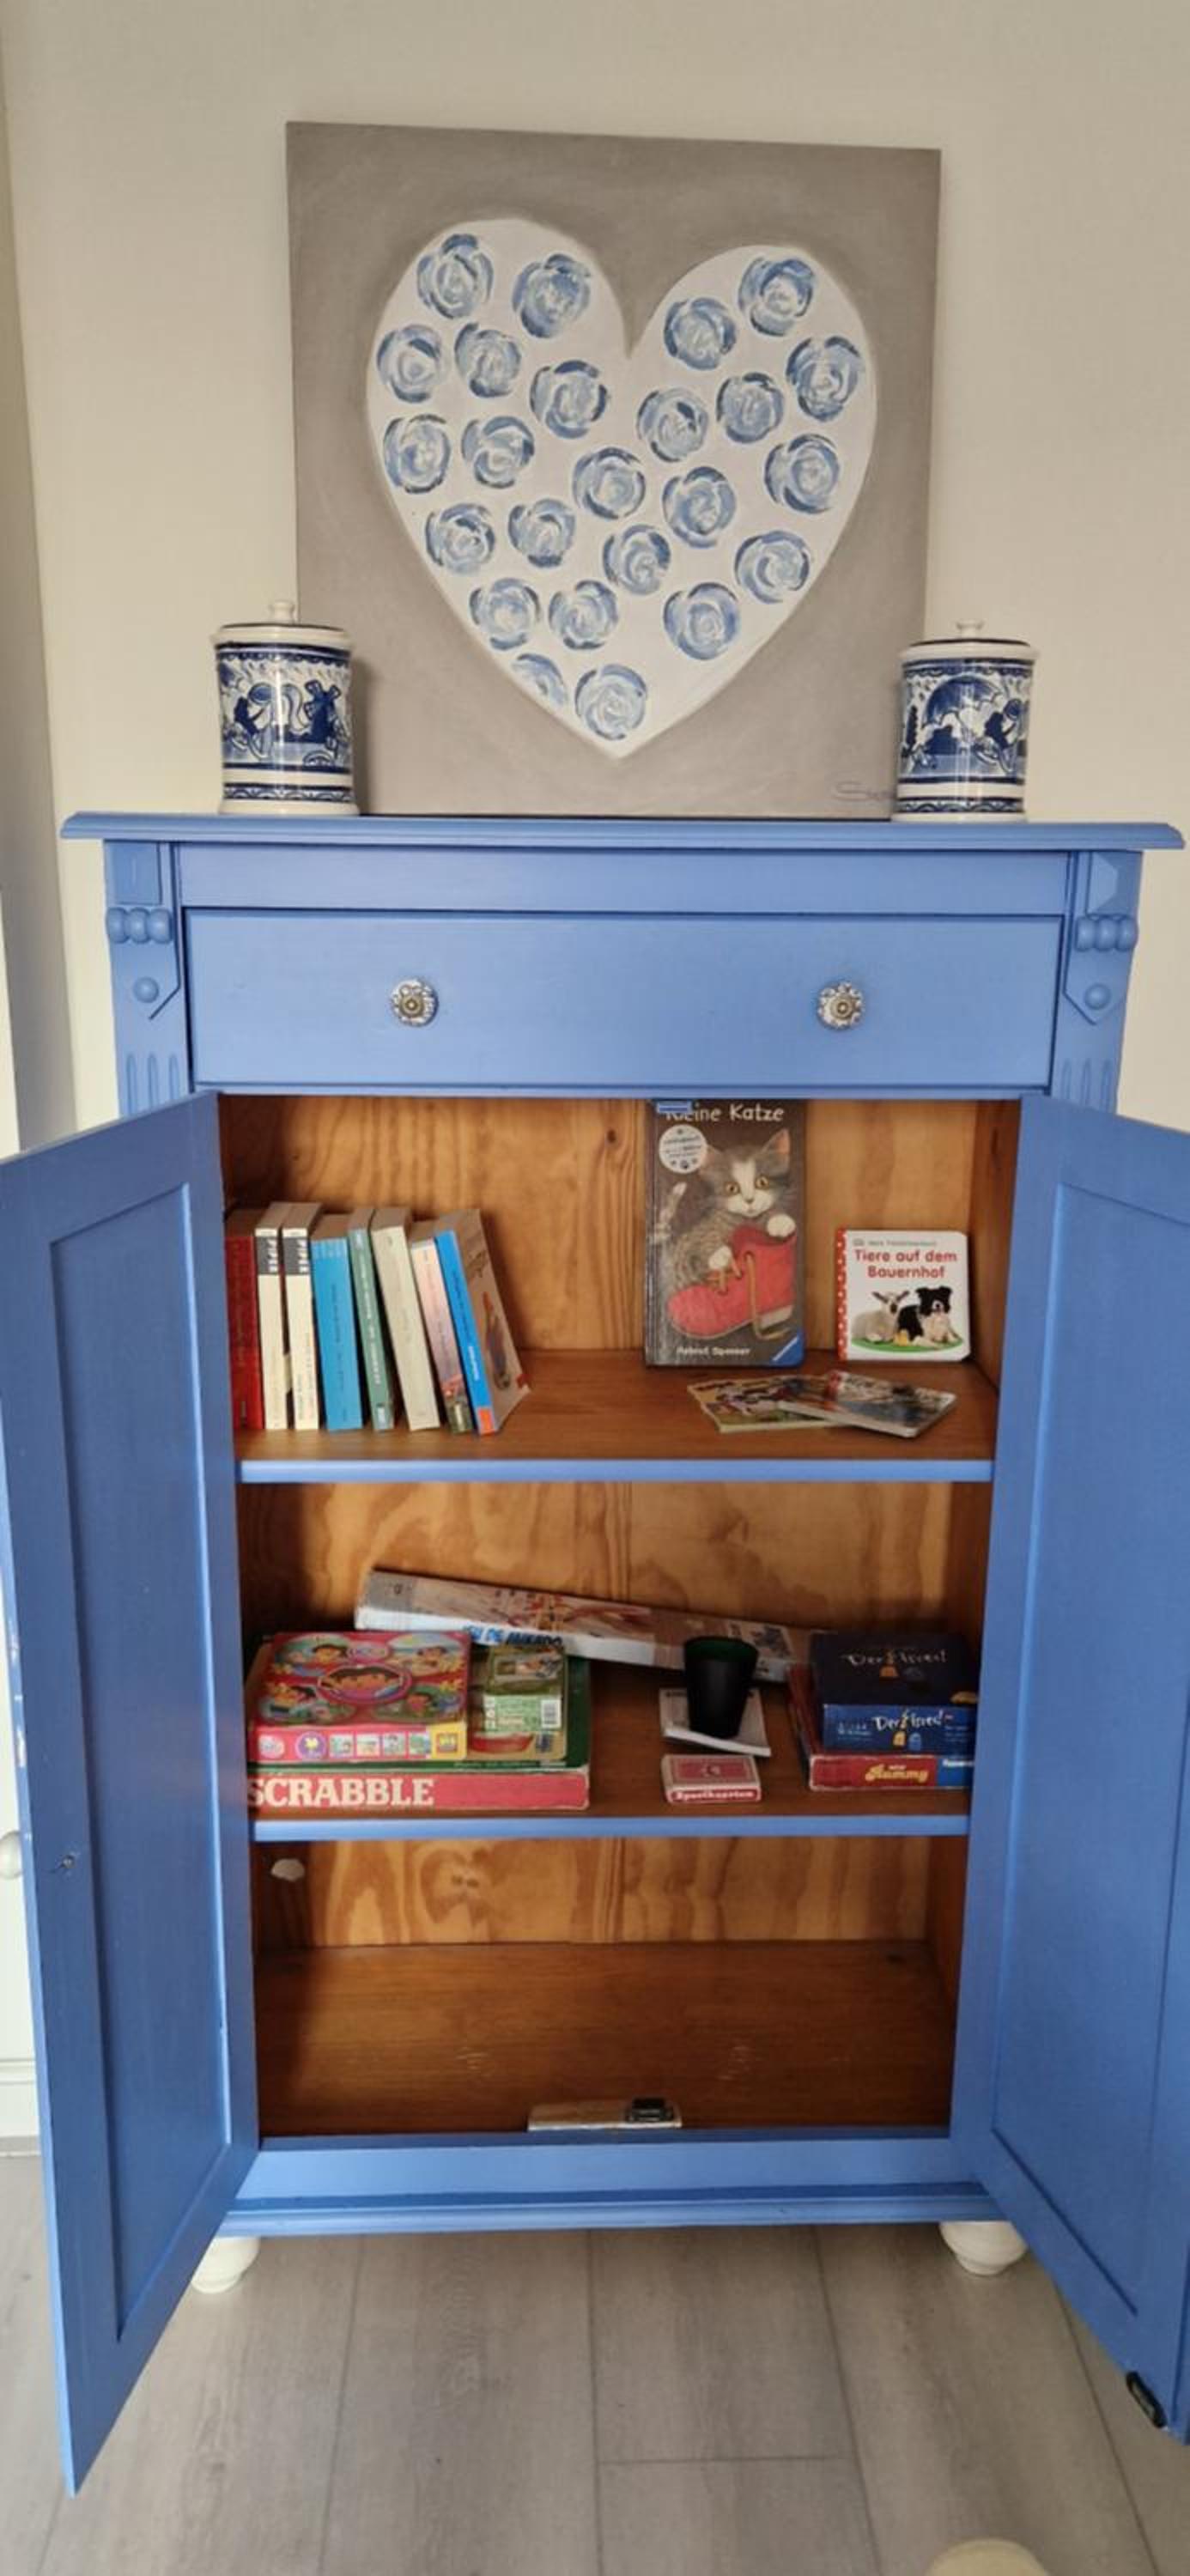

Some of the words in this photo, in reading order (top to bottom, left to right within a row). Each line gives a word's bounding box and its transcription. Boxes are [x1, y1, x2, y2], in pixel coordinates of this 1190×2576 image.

[730, 1103, 785, 1121] Katze
[854, 1249, 890, 1262] Tiere
[896, 1249, 920, 1262] auf
[925, 1249, 957, 1262] dem
[867, 1265, 945, 1279] Bauernhof
[865, 1763, 929, 1783] Rummy
[247, 1777, 434, 1807] SCRABBLE
